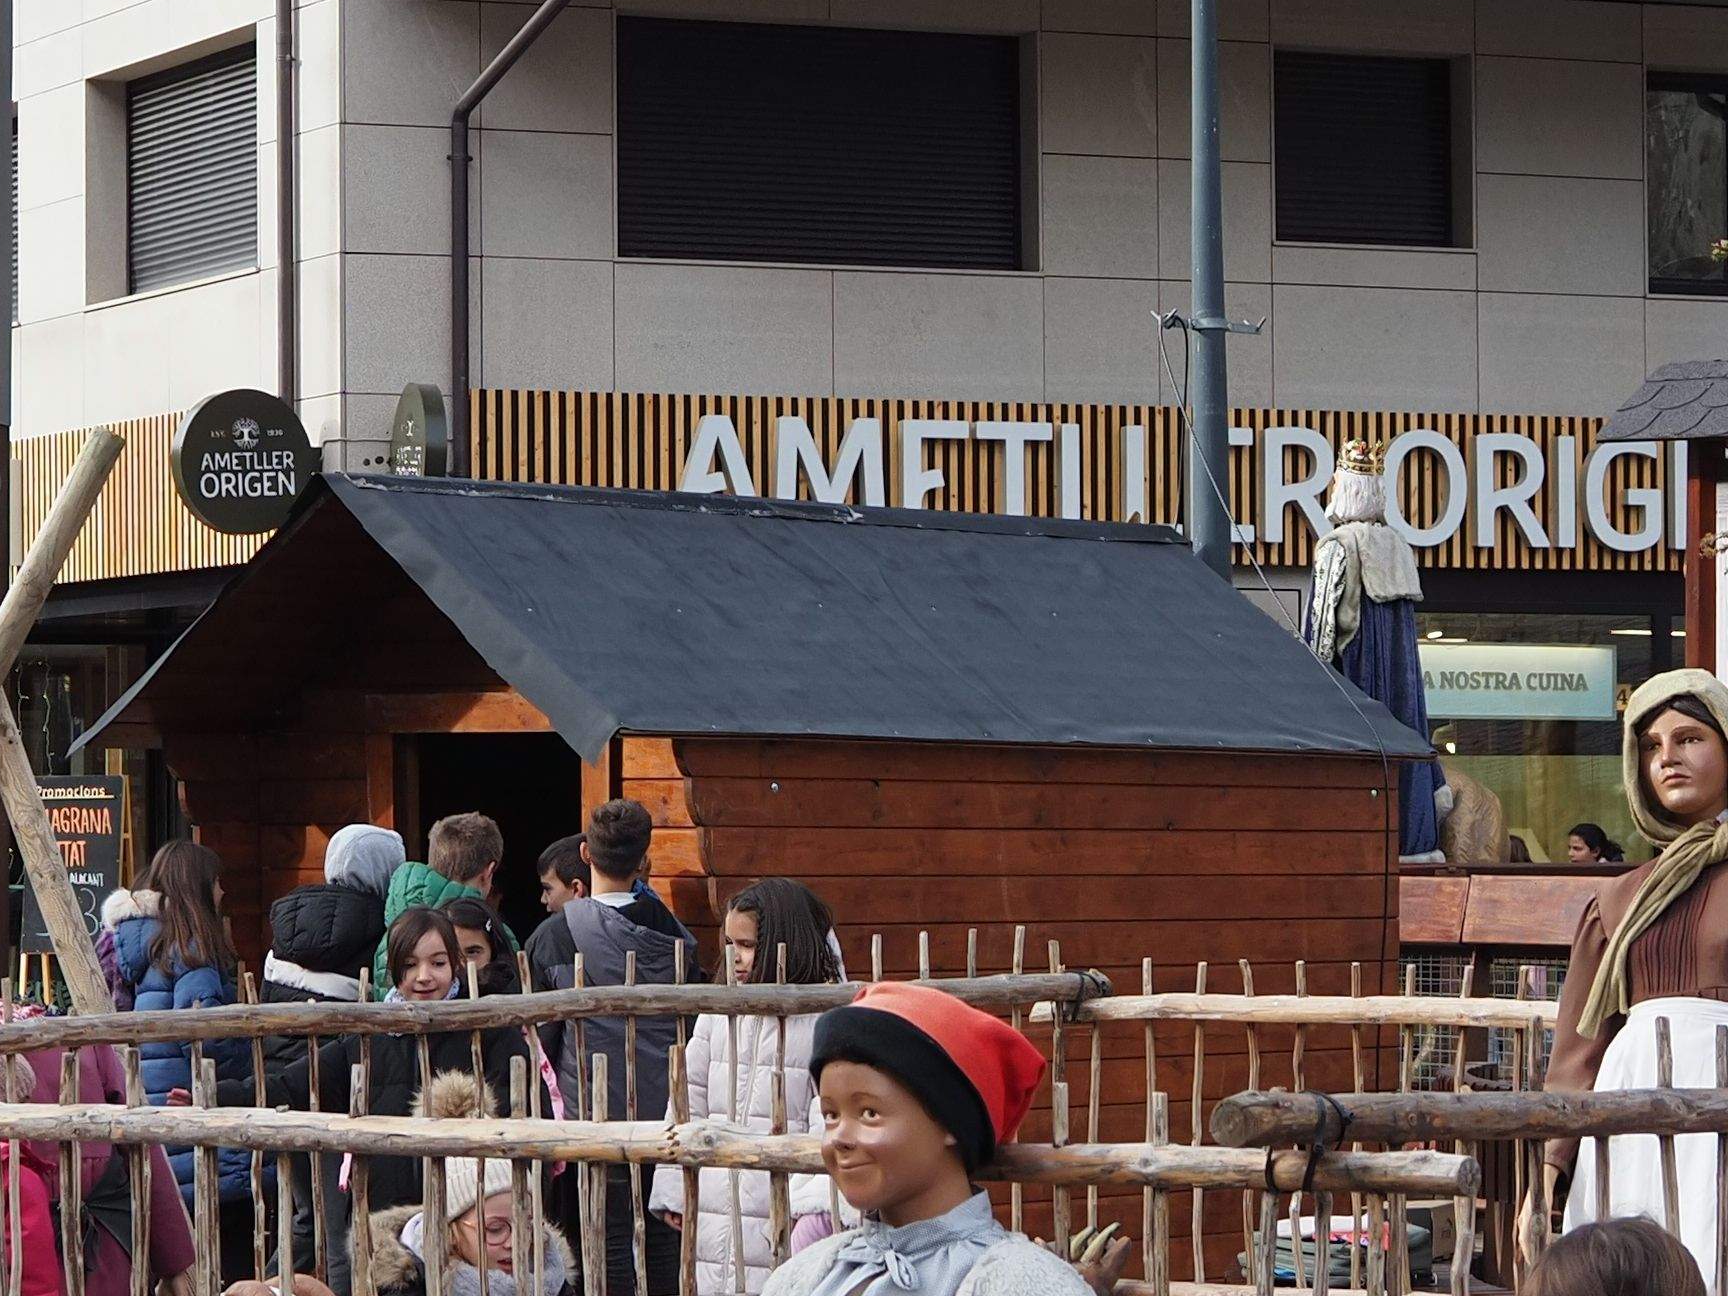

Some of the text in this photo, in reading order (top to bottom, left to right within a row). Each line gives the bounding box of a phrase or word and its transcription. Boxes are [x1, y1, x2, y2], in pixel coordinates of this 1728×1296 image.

[201, 451, 295, 472] AMETLLER
[200, 471, 296, 499] ORIGEN
[1384, 429, 1688, 552] ORIG
[1439, 671, 1522, 691] NOSTRA
[1526, 673, 1589, 692] CUINA
[45, 807, 112, 835] AGRANA
